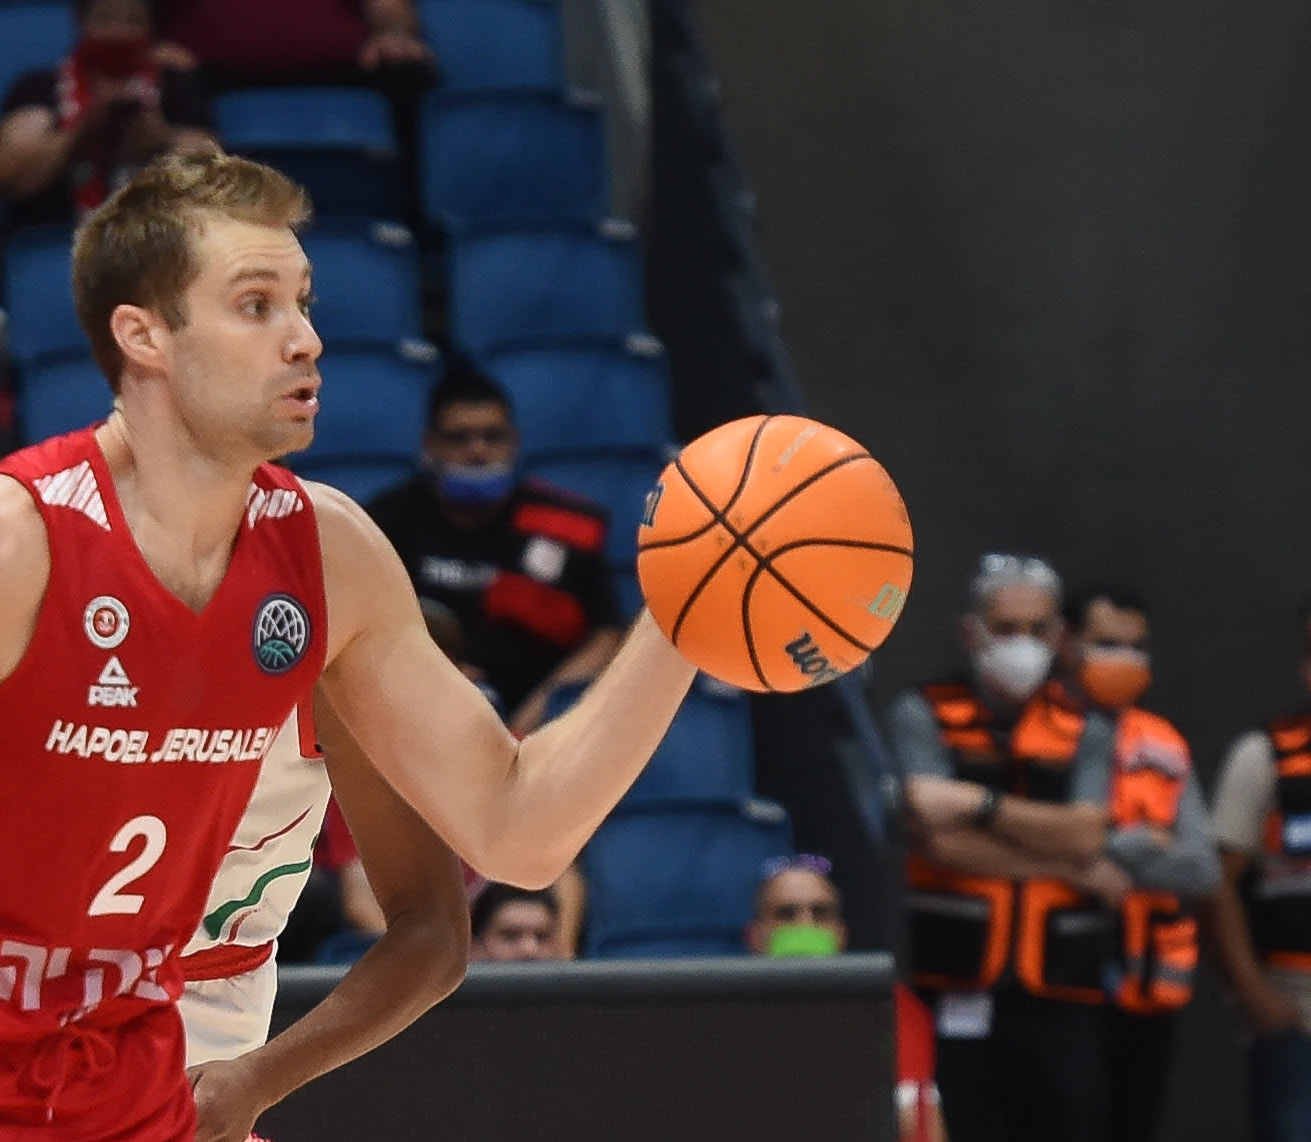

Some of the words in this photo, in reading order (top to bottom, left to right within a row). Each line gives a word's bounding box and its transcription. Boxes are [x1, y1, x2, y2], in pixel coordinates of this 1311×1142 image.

[88, 685, 141, 707] PEAK
[46, 719, 149, 764] HAPOEL
[88, 814, 167, 917] 2
